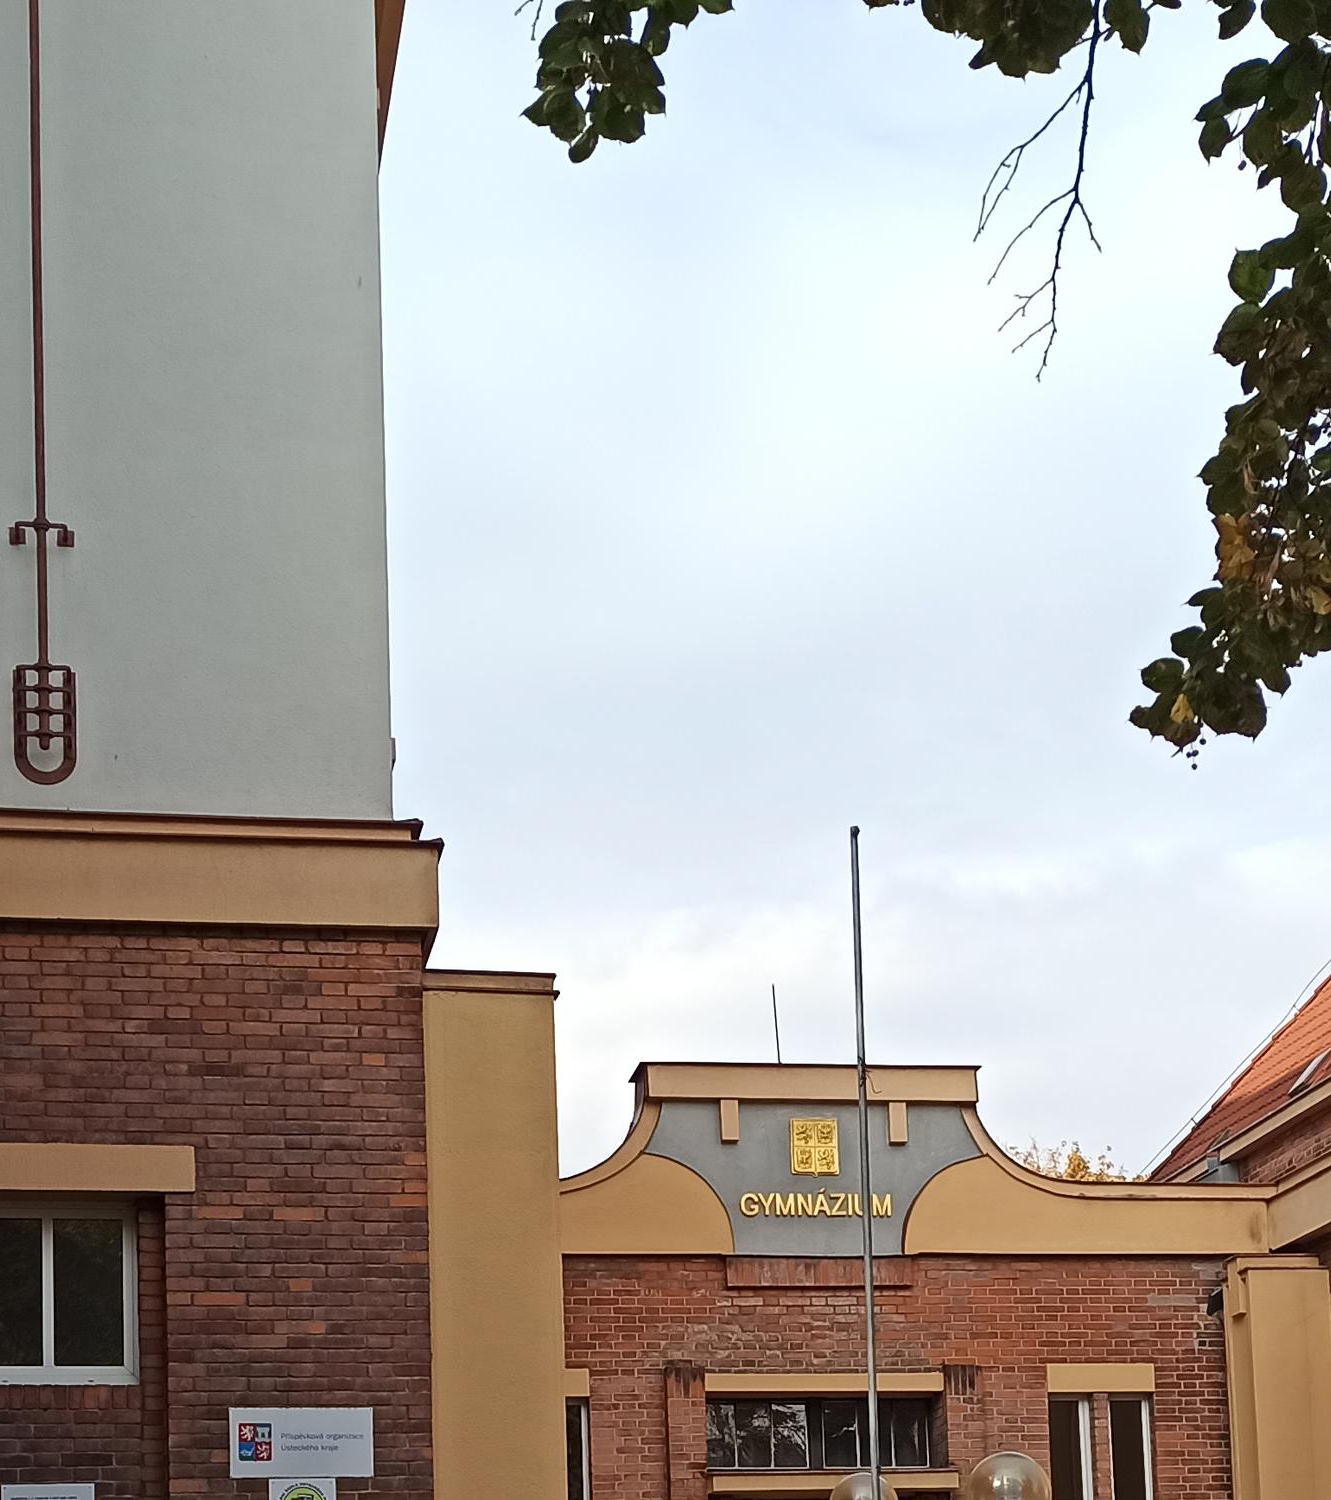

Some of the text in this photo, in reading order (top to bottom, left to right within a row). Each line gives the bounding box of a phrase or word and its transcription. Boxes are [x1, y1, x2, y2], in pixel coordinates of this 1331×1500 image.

[740, 1188, 893, 1217] GYMNÁZIUM
[326, 1433, 365, 1441] organizace
[321, 1444, 339, 1452] kraje
